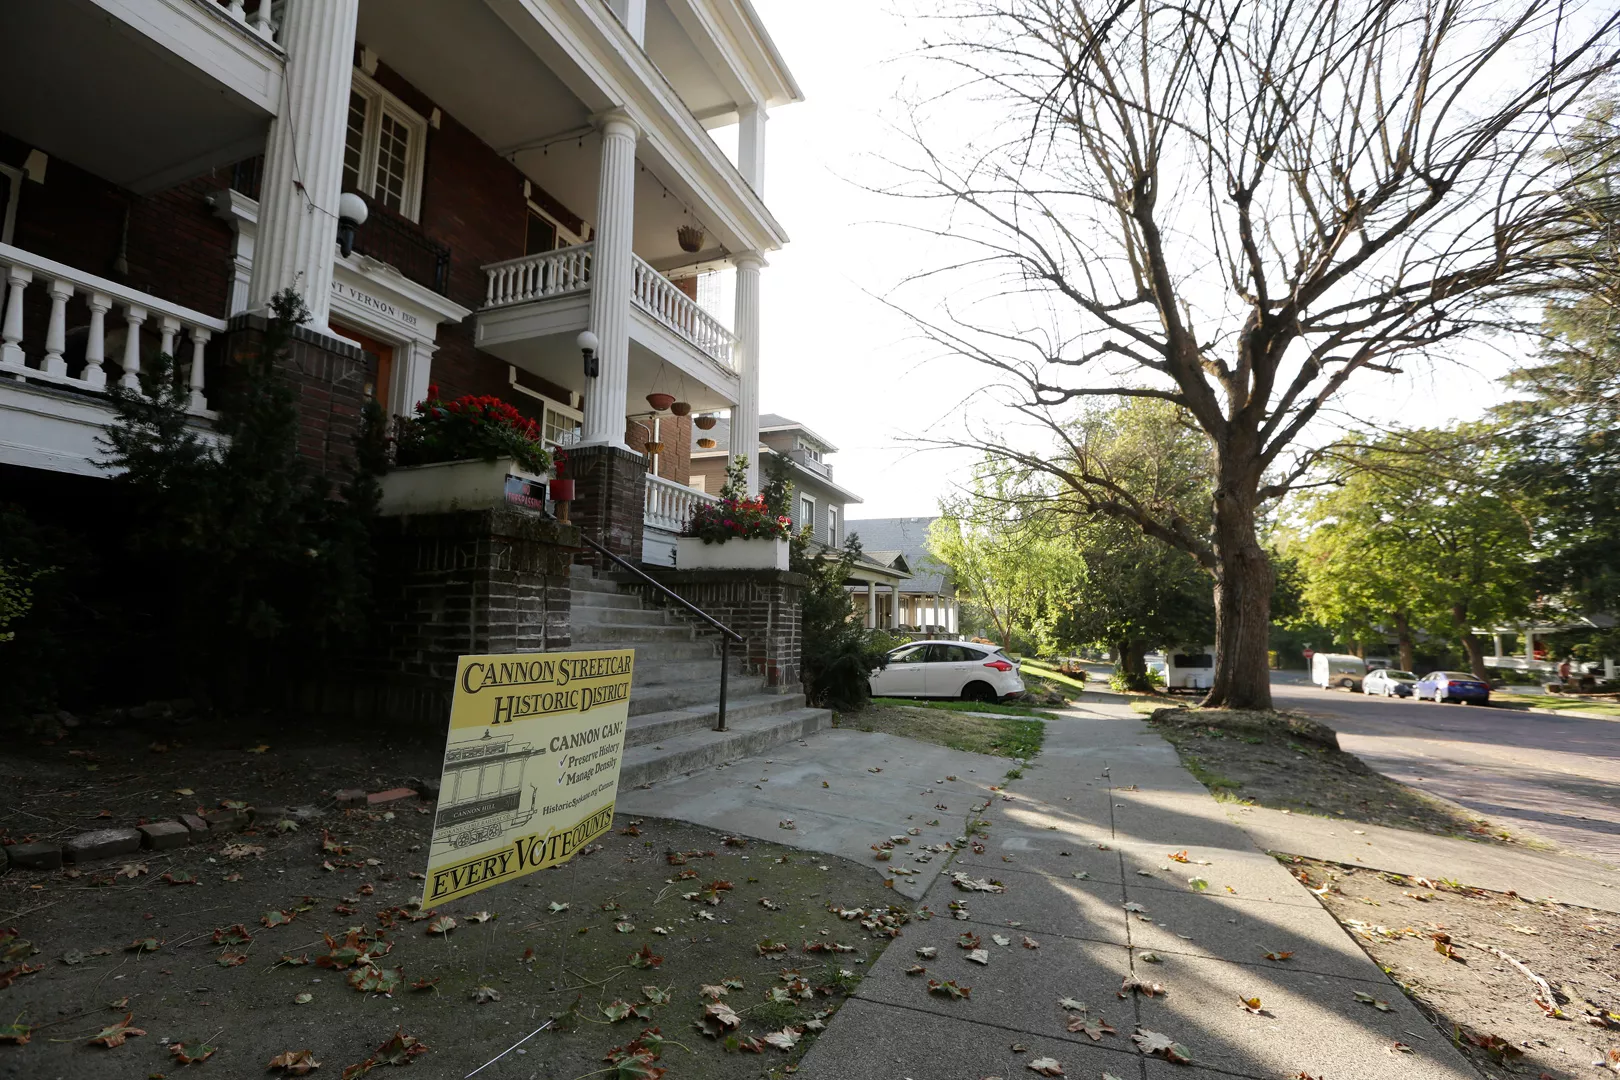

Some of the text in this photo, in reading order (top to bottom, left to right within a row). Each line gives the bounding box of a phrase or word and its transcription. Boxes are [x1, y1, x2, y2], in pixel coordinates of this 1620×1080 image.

[349, 288, 395, 316] VERNON
[508, 492, 542, 510] TRESPASSING
[461, 655, 631, 694] CANNON STREETCAR
[491, 682, 629, 725] HISTORIC DISTRICT
[550, 721, 623, 752] CANNON CAN:
[568, 742, 620, 768] Preserve History
[566, 757, 618, 786] Manage Density
[453, 803, 496, 819] CANNON HILL
[430, 807, 613, 898] EVERY VOTE COUNTS
